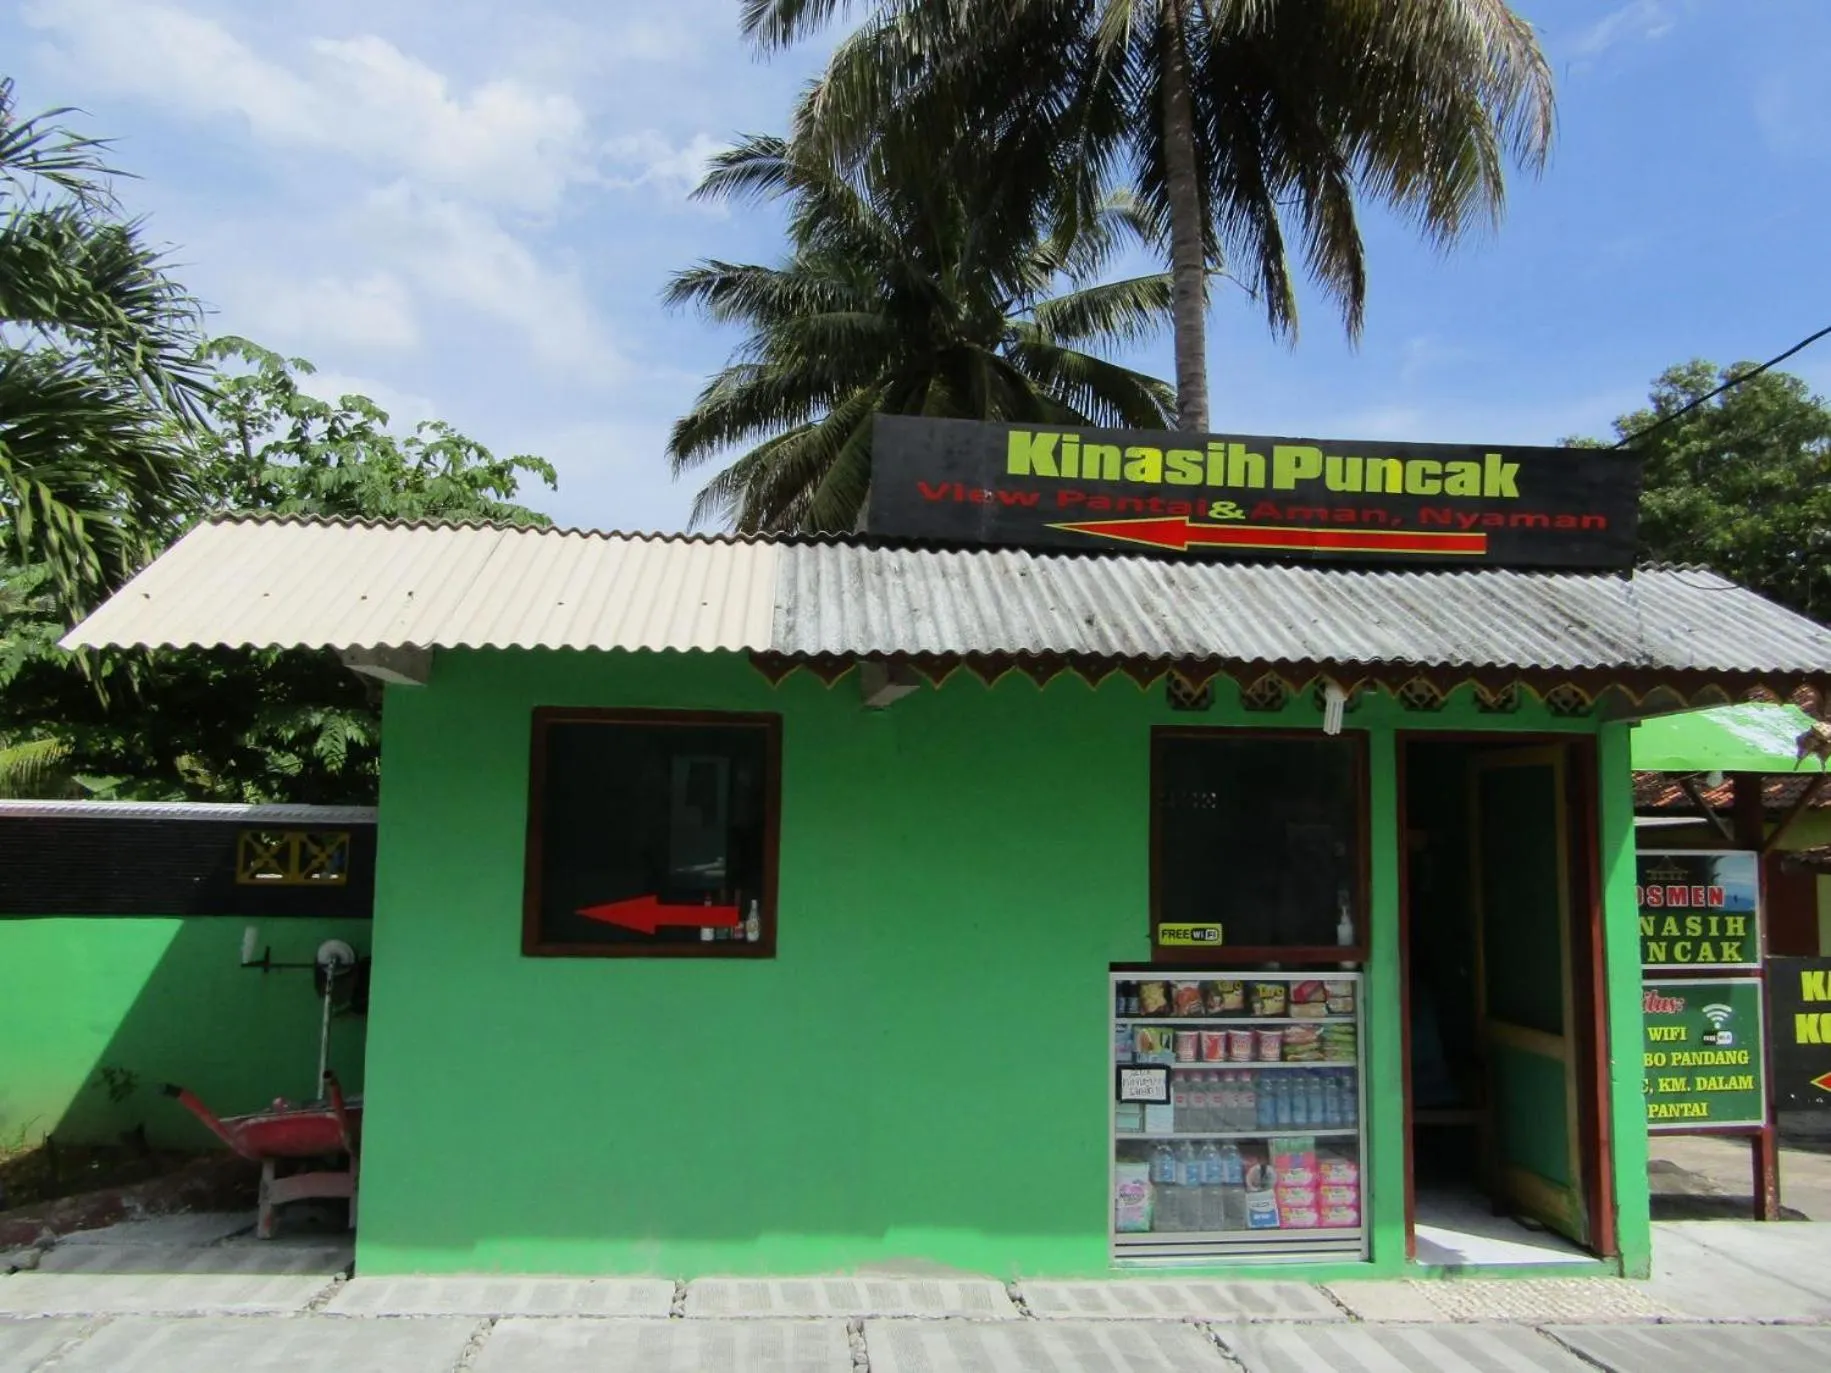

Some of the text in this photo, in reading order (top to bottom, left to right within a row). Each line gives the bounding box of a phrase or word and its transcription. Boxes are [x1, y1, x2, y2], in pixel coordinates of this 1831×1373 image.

[1007, 430, 1521, 498] Kinasih Puncak
[917, 481, 1040, 508] View
[1208, 500, 1246, 521] &
[1250, 500, 1404, 528] Aman,
[1418, 507, 1607, 531] Nyaman
[1161, 928, 1191, 940] FREE
[1646, 941, 1743, 963] NCAK
[1800, 970, 1831, 1001] K
[1647, 1026, 1687, 1042] WIFI
[1671, 1049, 1749, 1066] PANDANG
[1658, 1076, 1691, 1093] KM.
[1696, 1075, 1754, 1091] DALAM
[1648, 1102, 1709, 1118] PANTAI
